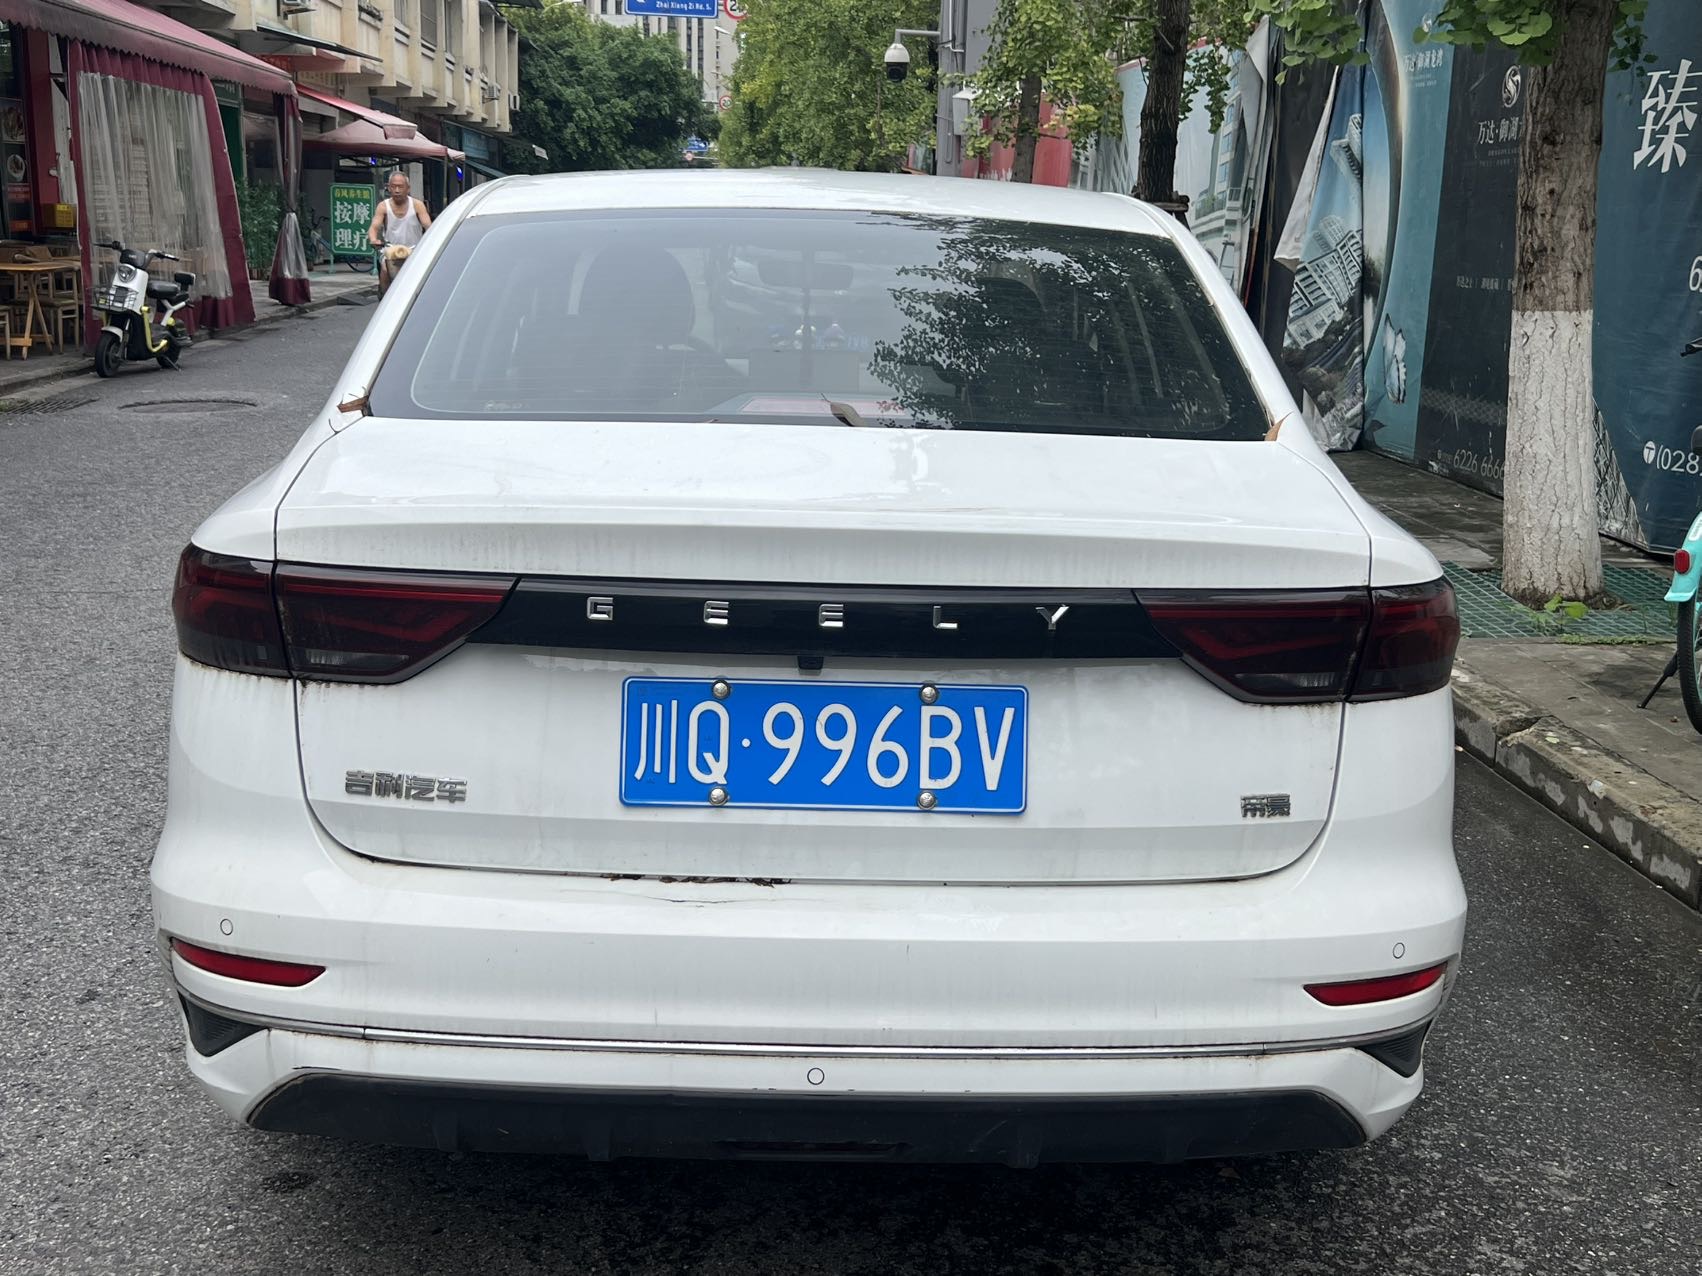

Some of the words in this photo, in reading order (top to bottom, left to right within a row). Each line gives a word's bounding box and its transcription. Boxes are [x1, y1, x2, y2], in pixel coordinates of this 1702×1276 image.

[1477, 116, 1522, 145] 万达·御湖
[1633, 58, 1702, 174] 臻
[334, 200, 370, 225] 按摩
[334, 228, 369, 251] 理疗
[1453, 448, 1478, 473] 6226
[587, 596, 1070, 630] GEELY
[345, 770, 467, 803] 吉利汽车
